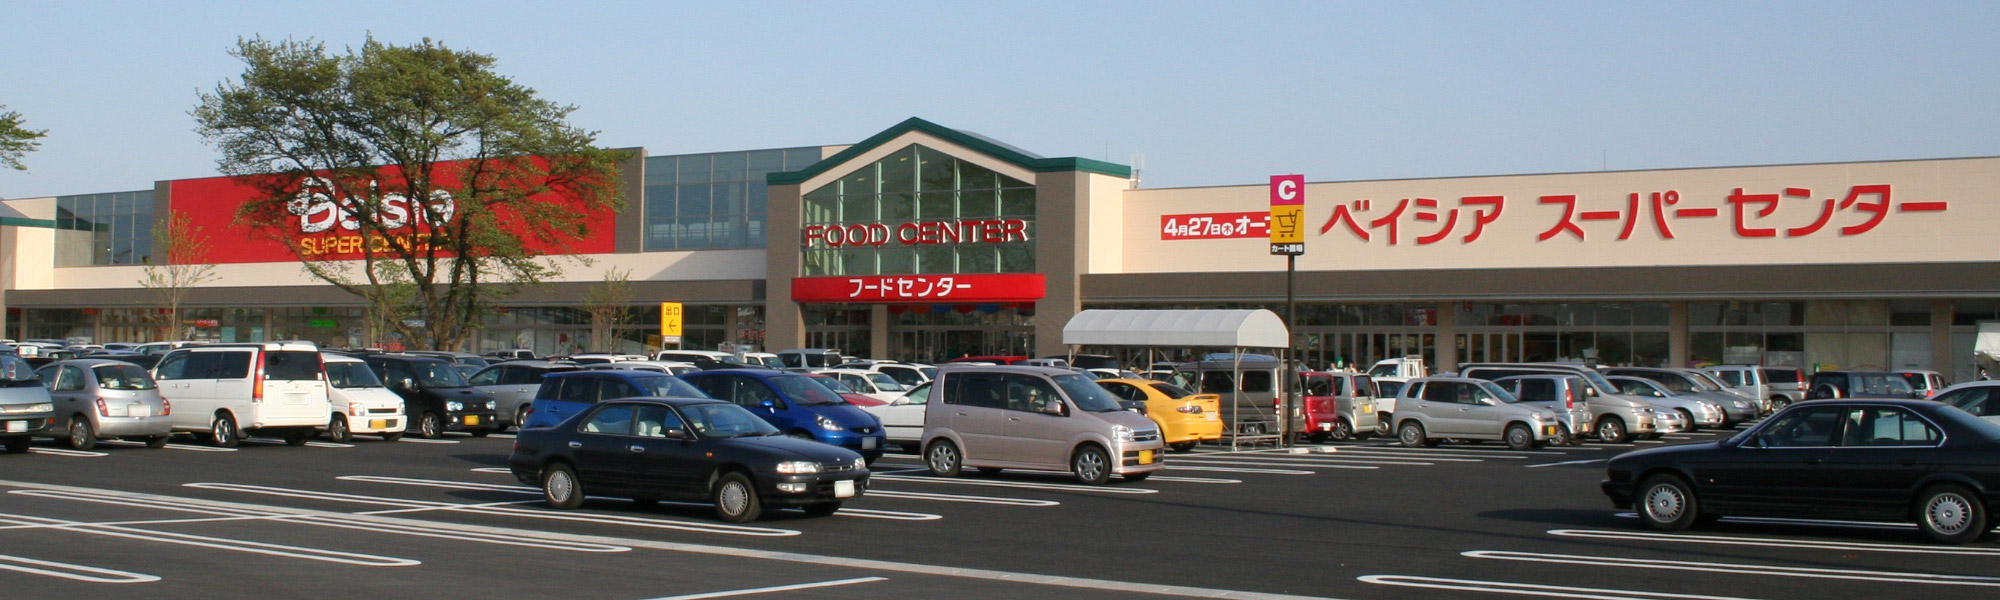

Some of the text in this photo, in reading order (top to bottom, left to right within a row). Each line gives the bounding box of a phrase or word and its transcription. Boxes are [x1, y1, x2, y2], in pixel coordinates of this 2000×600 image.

[1277, 179, 1297, 200] C
[1320, 184, 1948, 245] ベイシア スーパーセンター
[805, 219, 1029, 248] FOOD CENTER
[301, 236, 363, 256] SUPER
[849, 277, 972, 298] フードセンター
